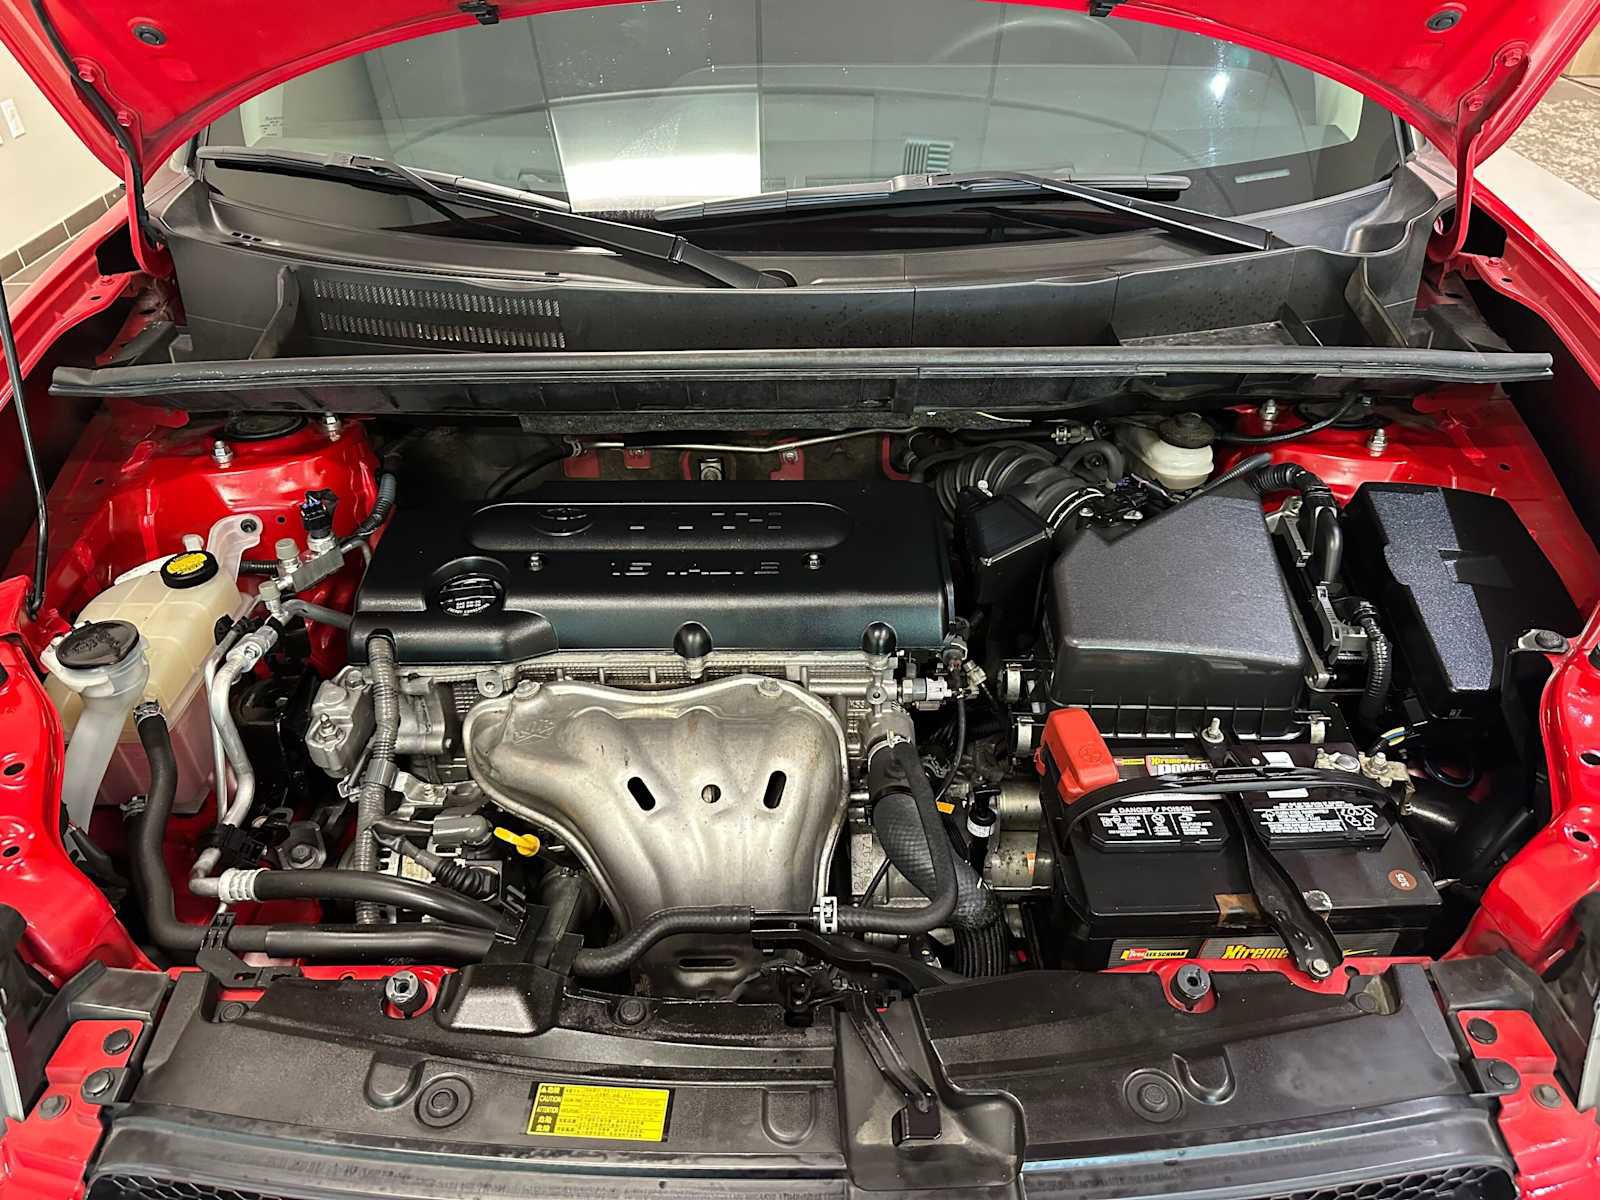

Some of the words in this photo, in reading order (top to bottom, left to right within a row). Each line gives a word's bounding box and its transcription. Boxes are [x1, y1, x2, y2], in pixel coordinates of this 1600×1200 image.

[1118, 806, 1154, 814] DANGER
[1161, 805, 1194, 813] POISON
[1221, 944, 1290, 959] Xtreme
[539, 1095, 562, 1103] CAUTION
